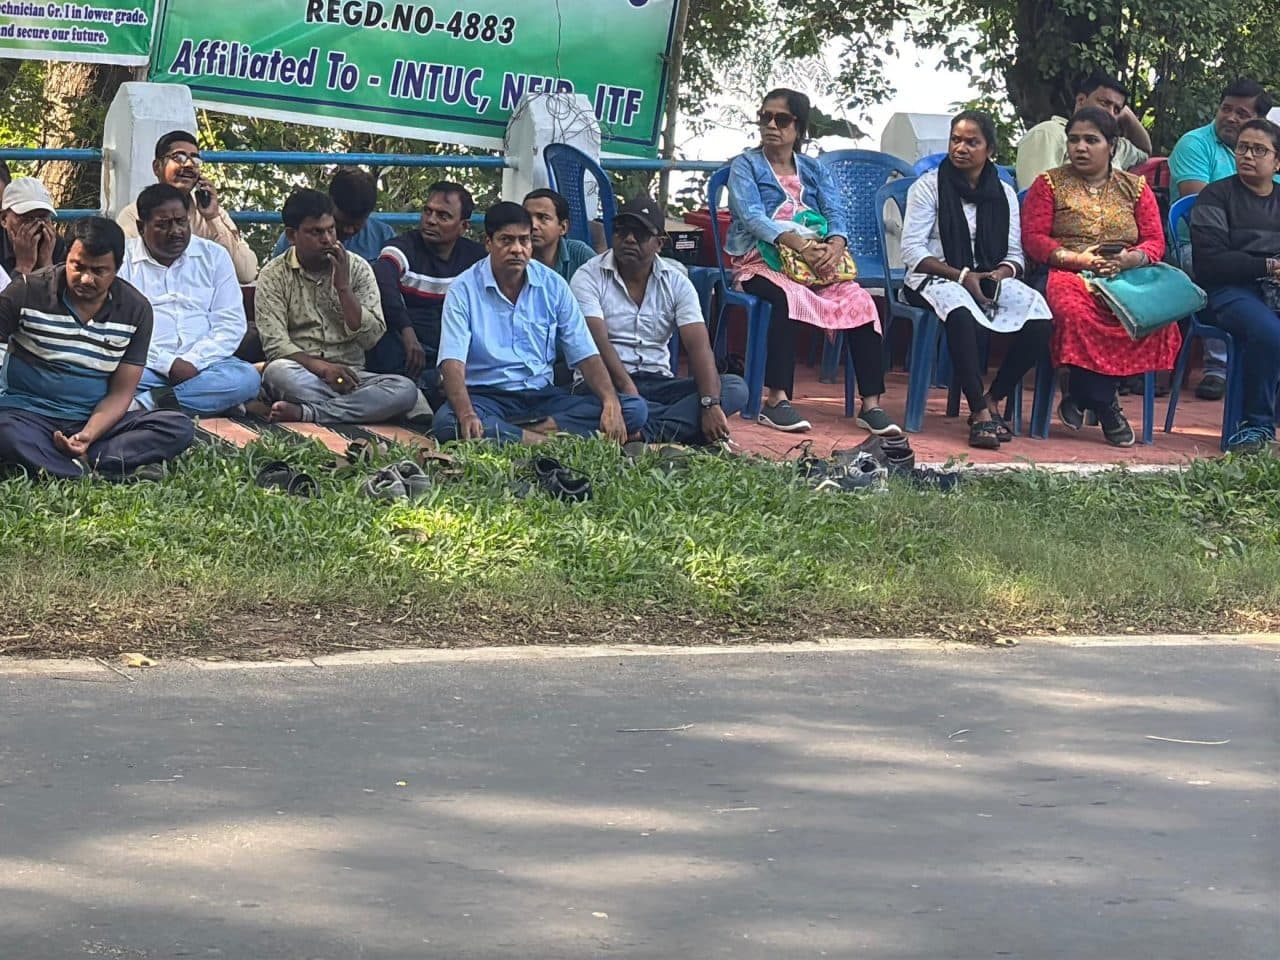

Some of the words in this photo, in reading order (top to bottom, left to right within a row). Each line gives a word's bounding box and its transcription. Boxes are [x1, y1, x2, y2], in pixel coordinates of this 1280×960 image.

[47, 4, 62, 18] Gr.
[71, 6, 82, 20] in
[84, 6, 113, 21] lower
[114, 9, 147, 24] grade.
[17, 27, 49, 40] secure
[52, 29, 69, 41] our
[72, 27, 107, 42] future.
[170, 40, 318, 85] Affiliated
[328, 52, 358, 90] To
[390, 61, 490, 112] INTUC,
[594, 85, 642, 124] ITF
